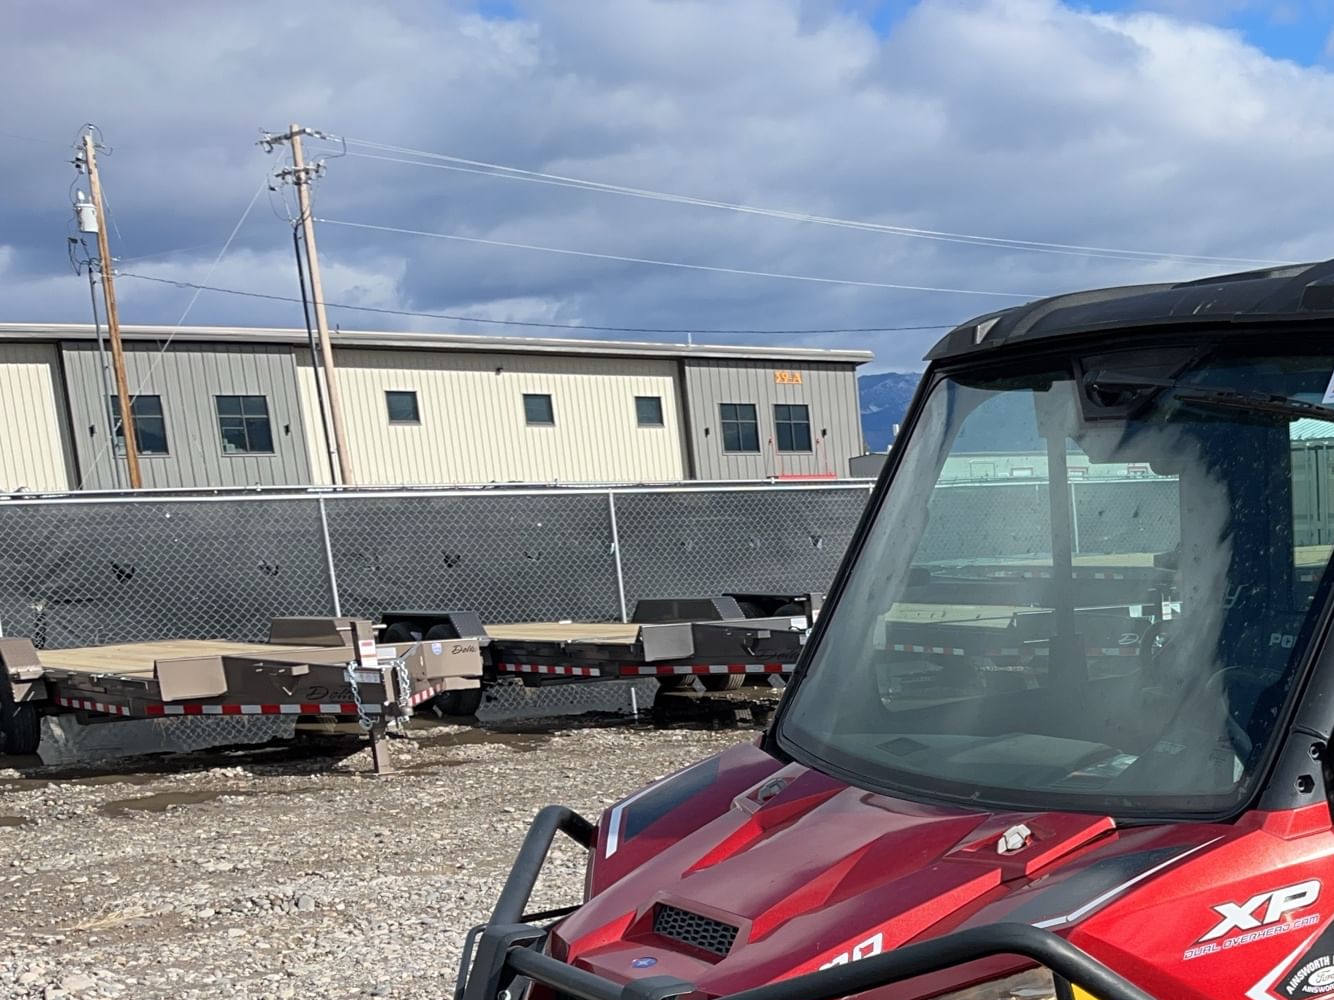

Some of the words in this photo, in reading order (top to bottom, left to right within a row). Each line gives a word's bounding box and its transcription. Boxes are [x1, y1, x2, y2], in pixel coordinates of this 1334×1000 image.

[1197, 879, 1321, 943] XP
[1183, 943, 1221, 960] DUAL
[1222, 921, 1292, 949] OVERHEAD
[1292, 913, 1320, 929] CAM
[1286, 955, 1330, 995] AINSWORTH
